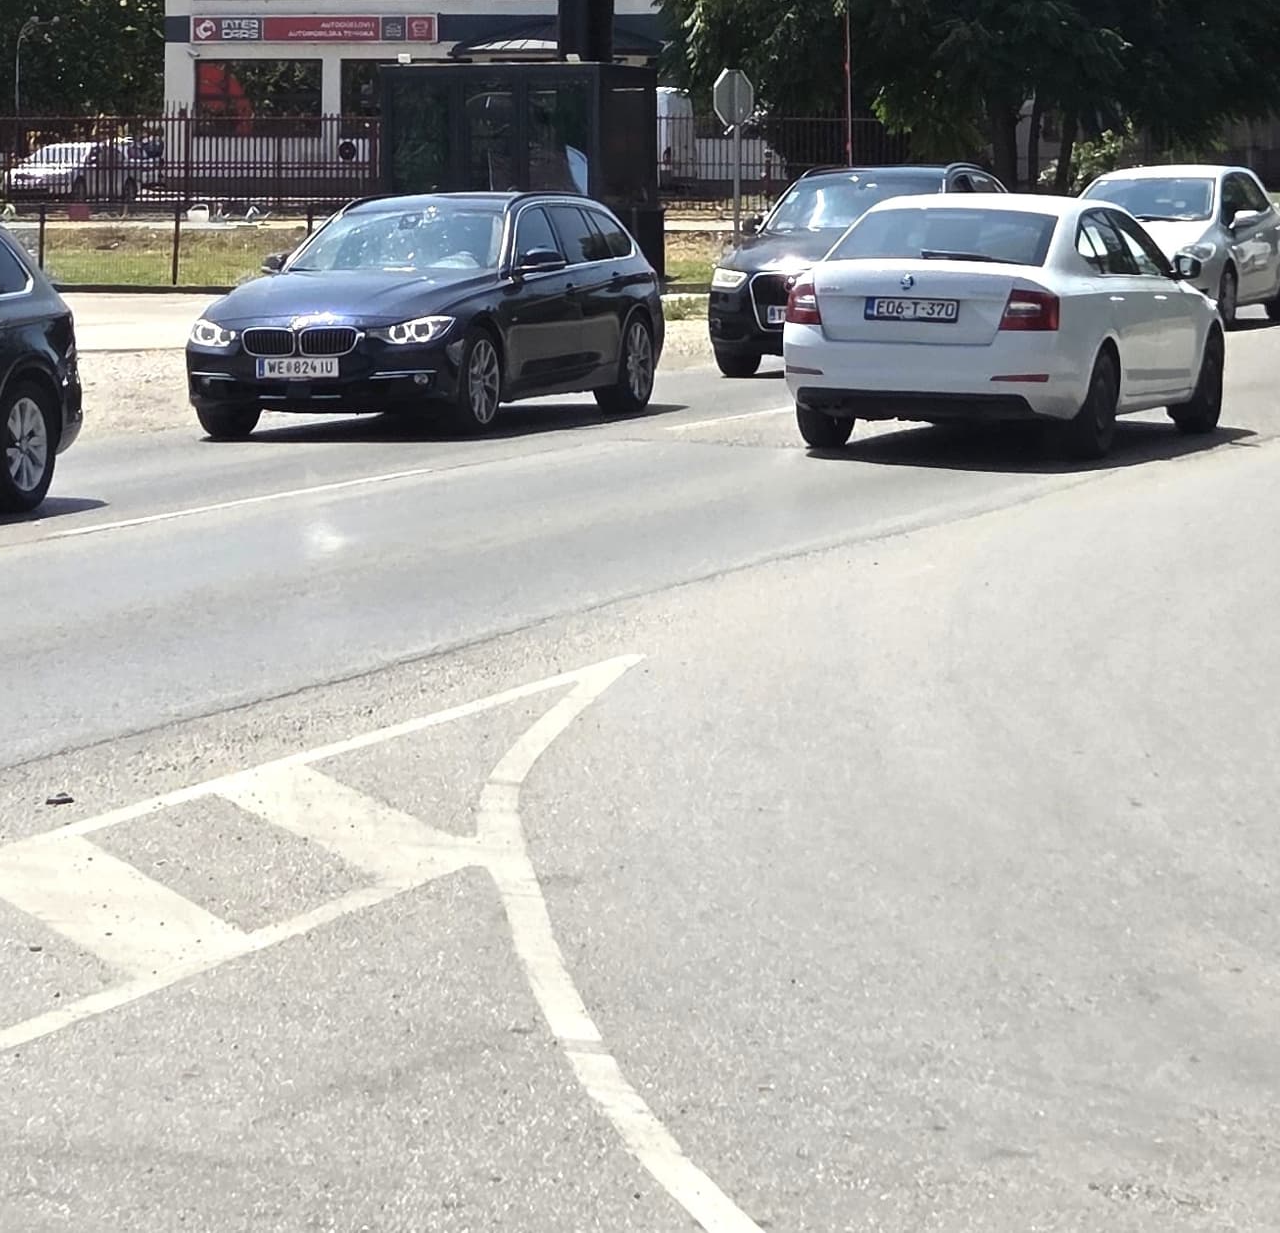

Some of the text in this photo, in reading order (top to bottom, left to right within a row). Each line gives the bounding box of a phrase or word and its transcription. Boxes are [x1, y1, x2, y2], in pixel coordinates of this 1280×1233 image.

[221, 19, 258, 29] INTER
[876, 299, 955, 317] E06-T-370
[267, 361, 284, 374] WE
